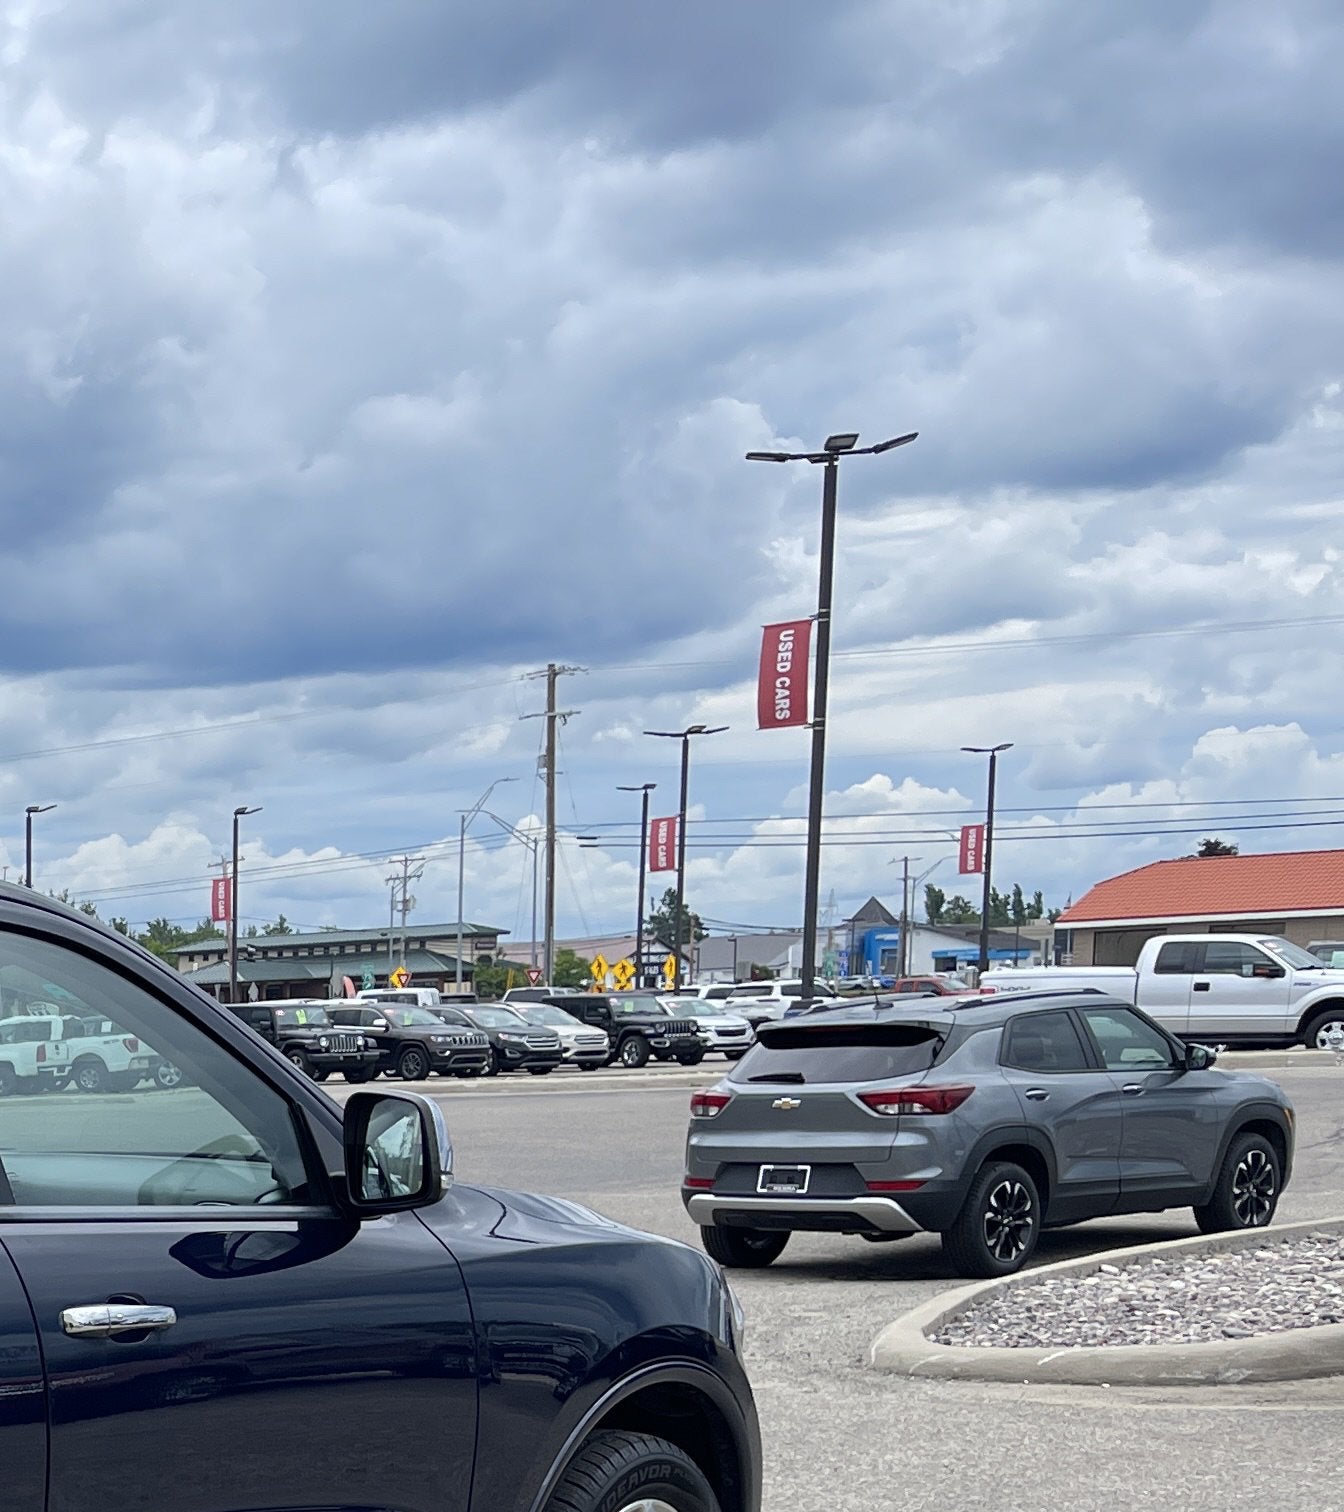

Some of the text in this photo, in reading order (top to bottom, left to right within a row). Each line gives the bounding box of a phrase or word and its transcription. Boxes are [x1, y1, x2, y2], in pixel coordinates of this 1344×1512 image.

[775, 629, 795, 720] USED CARS
[657, 820, 668, 868] USED CARS
